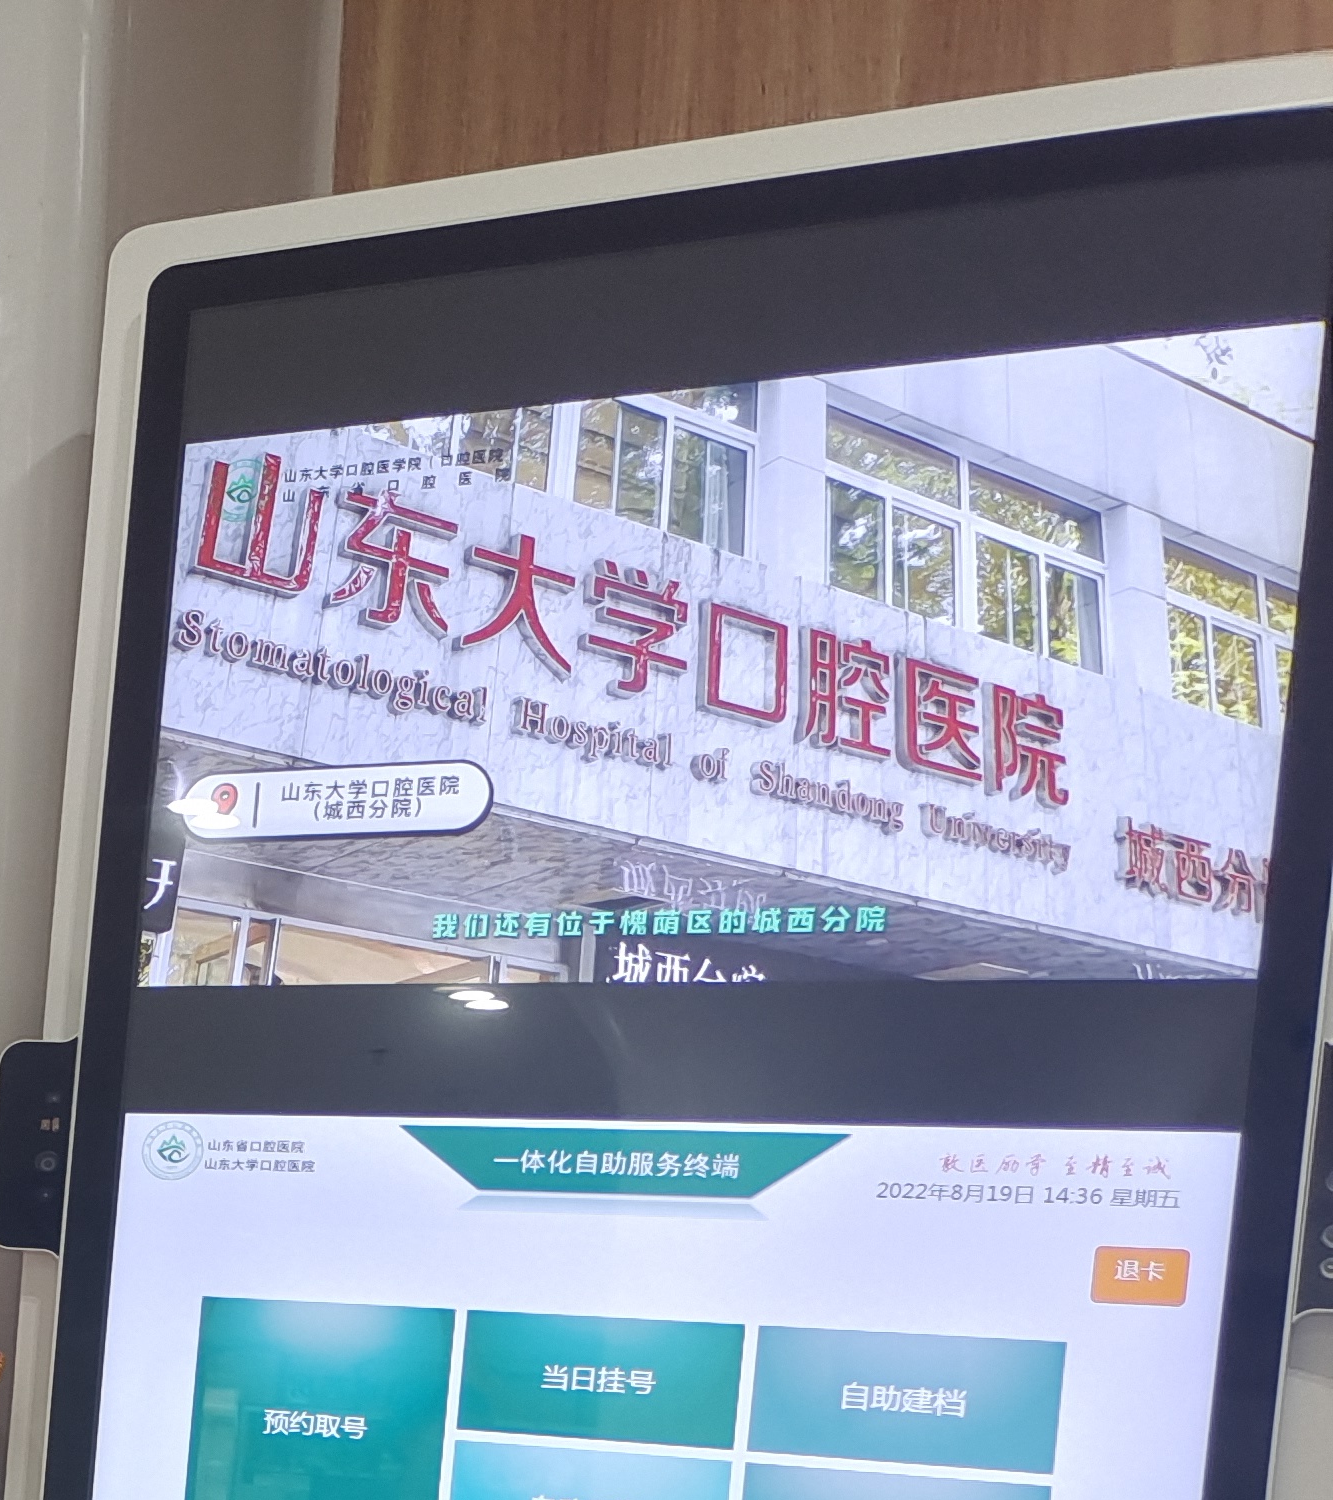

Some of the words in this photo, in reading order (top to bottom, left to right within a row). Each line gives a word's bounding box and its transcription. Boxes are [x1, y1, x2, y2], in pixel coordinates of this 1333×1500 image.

[195, 455, 1070, 807] 山东大学口腔医院
[176, 608, 489, 722] Stomatological
[517, 697, 673, 768] Hospital
[695, 747, 730, 782] of
[755, 760, 905, 834] Shandong
[281, 775, 461, 802] 山东大学口腔医院
[1118, 817, 1270, 920] 城西分
[207, 1139, 306, 1154] 山东省口腔医院
[204, 1158, 316, 1173] 山东大学口腔医院
[492, 1148, 741, 1181] 一体化自助服务终端
[876, 1182, 1034, 1204] 2022年8月19日
[1044, 1186, 1103, 1205] 14:36
[1109, 1188, 1181, 1209] 星期五
[1113, 1259, 1166, 1283] 退卡
[540, 1364, 656, 1396] 当日挂号
[840, 1381, 967, 1418] 自助建档
[262, 1408, 368, 1440] 预约取号
